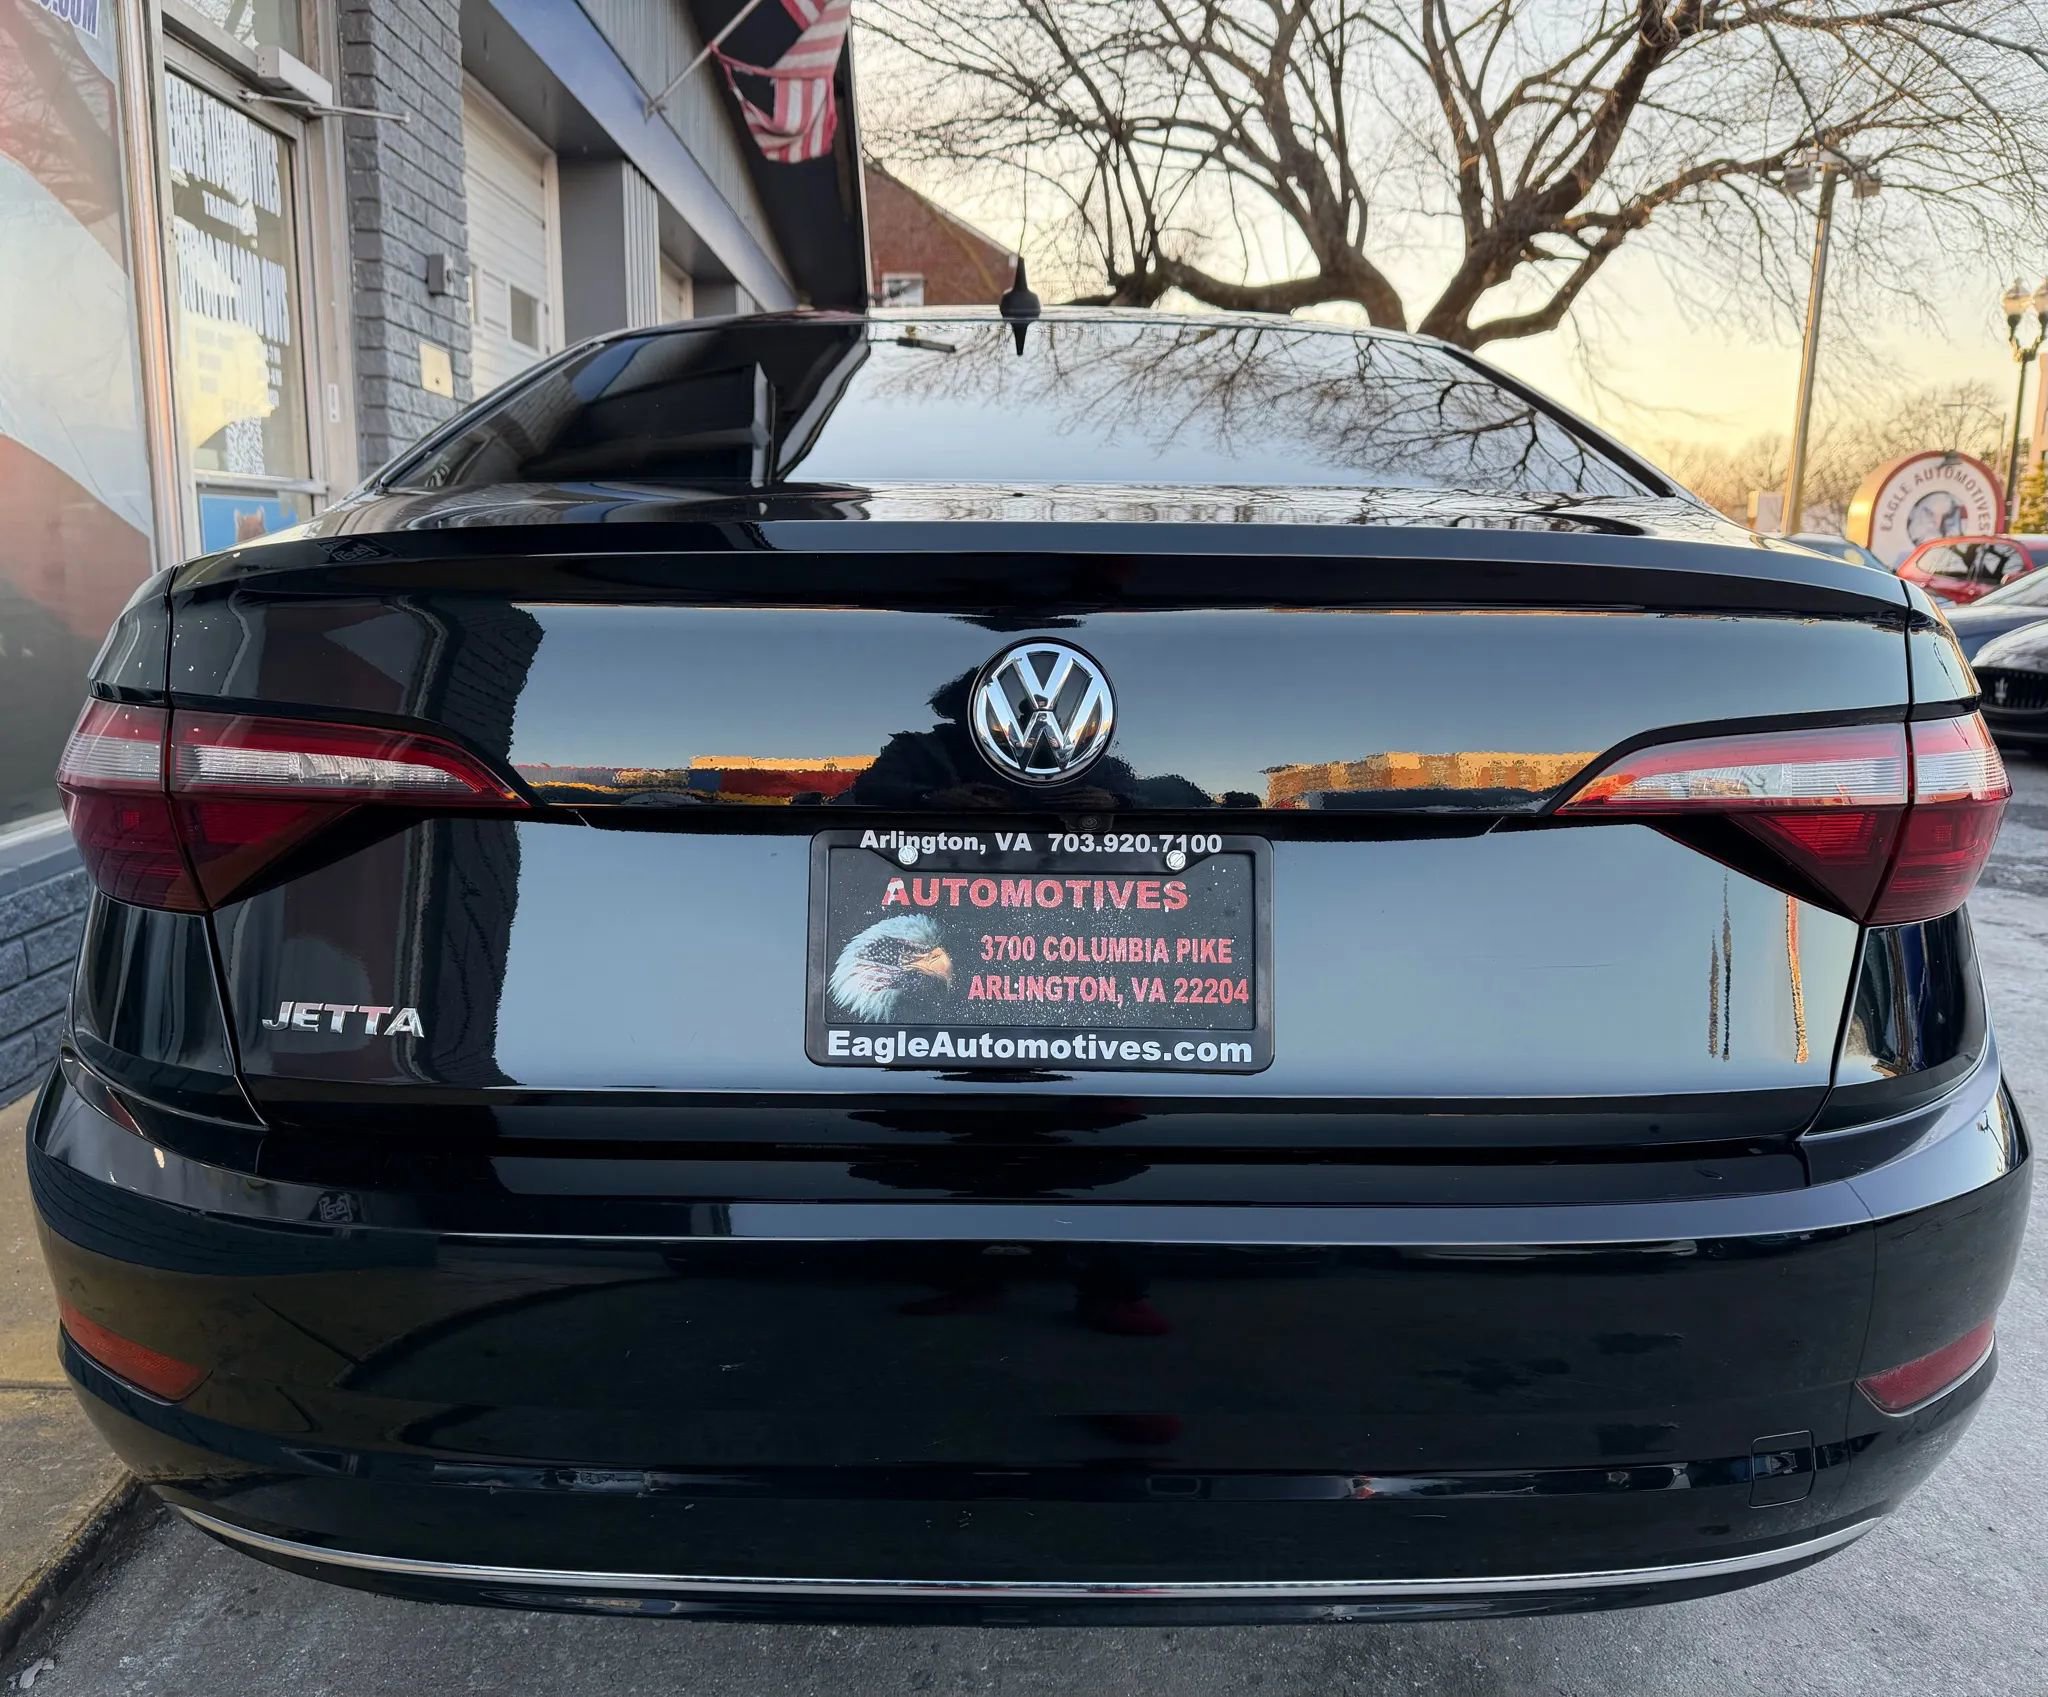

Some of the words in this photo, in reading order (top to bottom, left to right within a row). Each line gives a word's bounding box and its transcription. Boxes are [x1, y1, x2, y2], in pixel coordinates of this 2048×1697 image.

[1880, 482, 1912, 532] EAGLE
[1914, 465, 1991, 532] AUTOMOTIVES
[976, 642, 1113, 775] VW
[860, 830, 986, 854] Arlington,
[994, 833, 1032, 851] VA
[1048, 834, 1222, 853] 703.920.7100
[881, 877, 1188, 910] AUTOMOTIVES
[981, 935, 1034, 962] 3700
[1043, 936, 1169, 963] COLUMBIA
[1176, 938, 1232, 964] PIKE
[967, 975, 1123, 1007] ARLINGTON,
[1132, 977, 1166, 1003] VA
[1173, 978, 1249, 1003] 22204
[262, 1001, 425, 1038] JETTA
[827, 1030, 1252, 1063] EagleAutomotives.com
